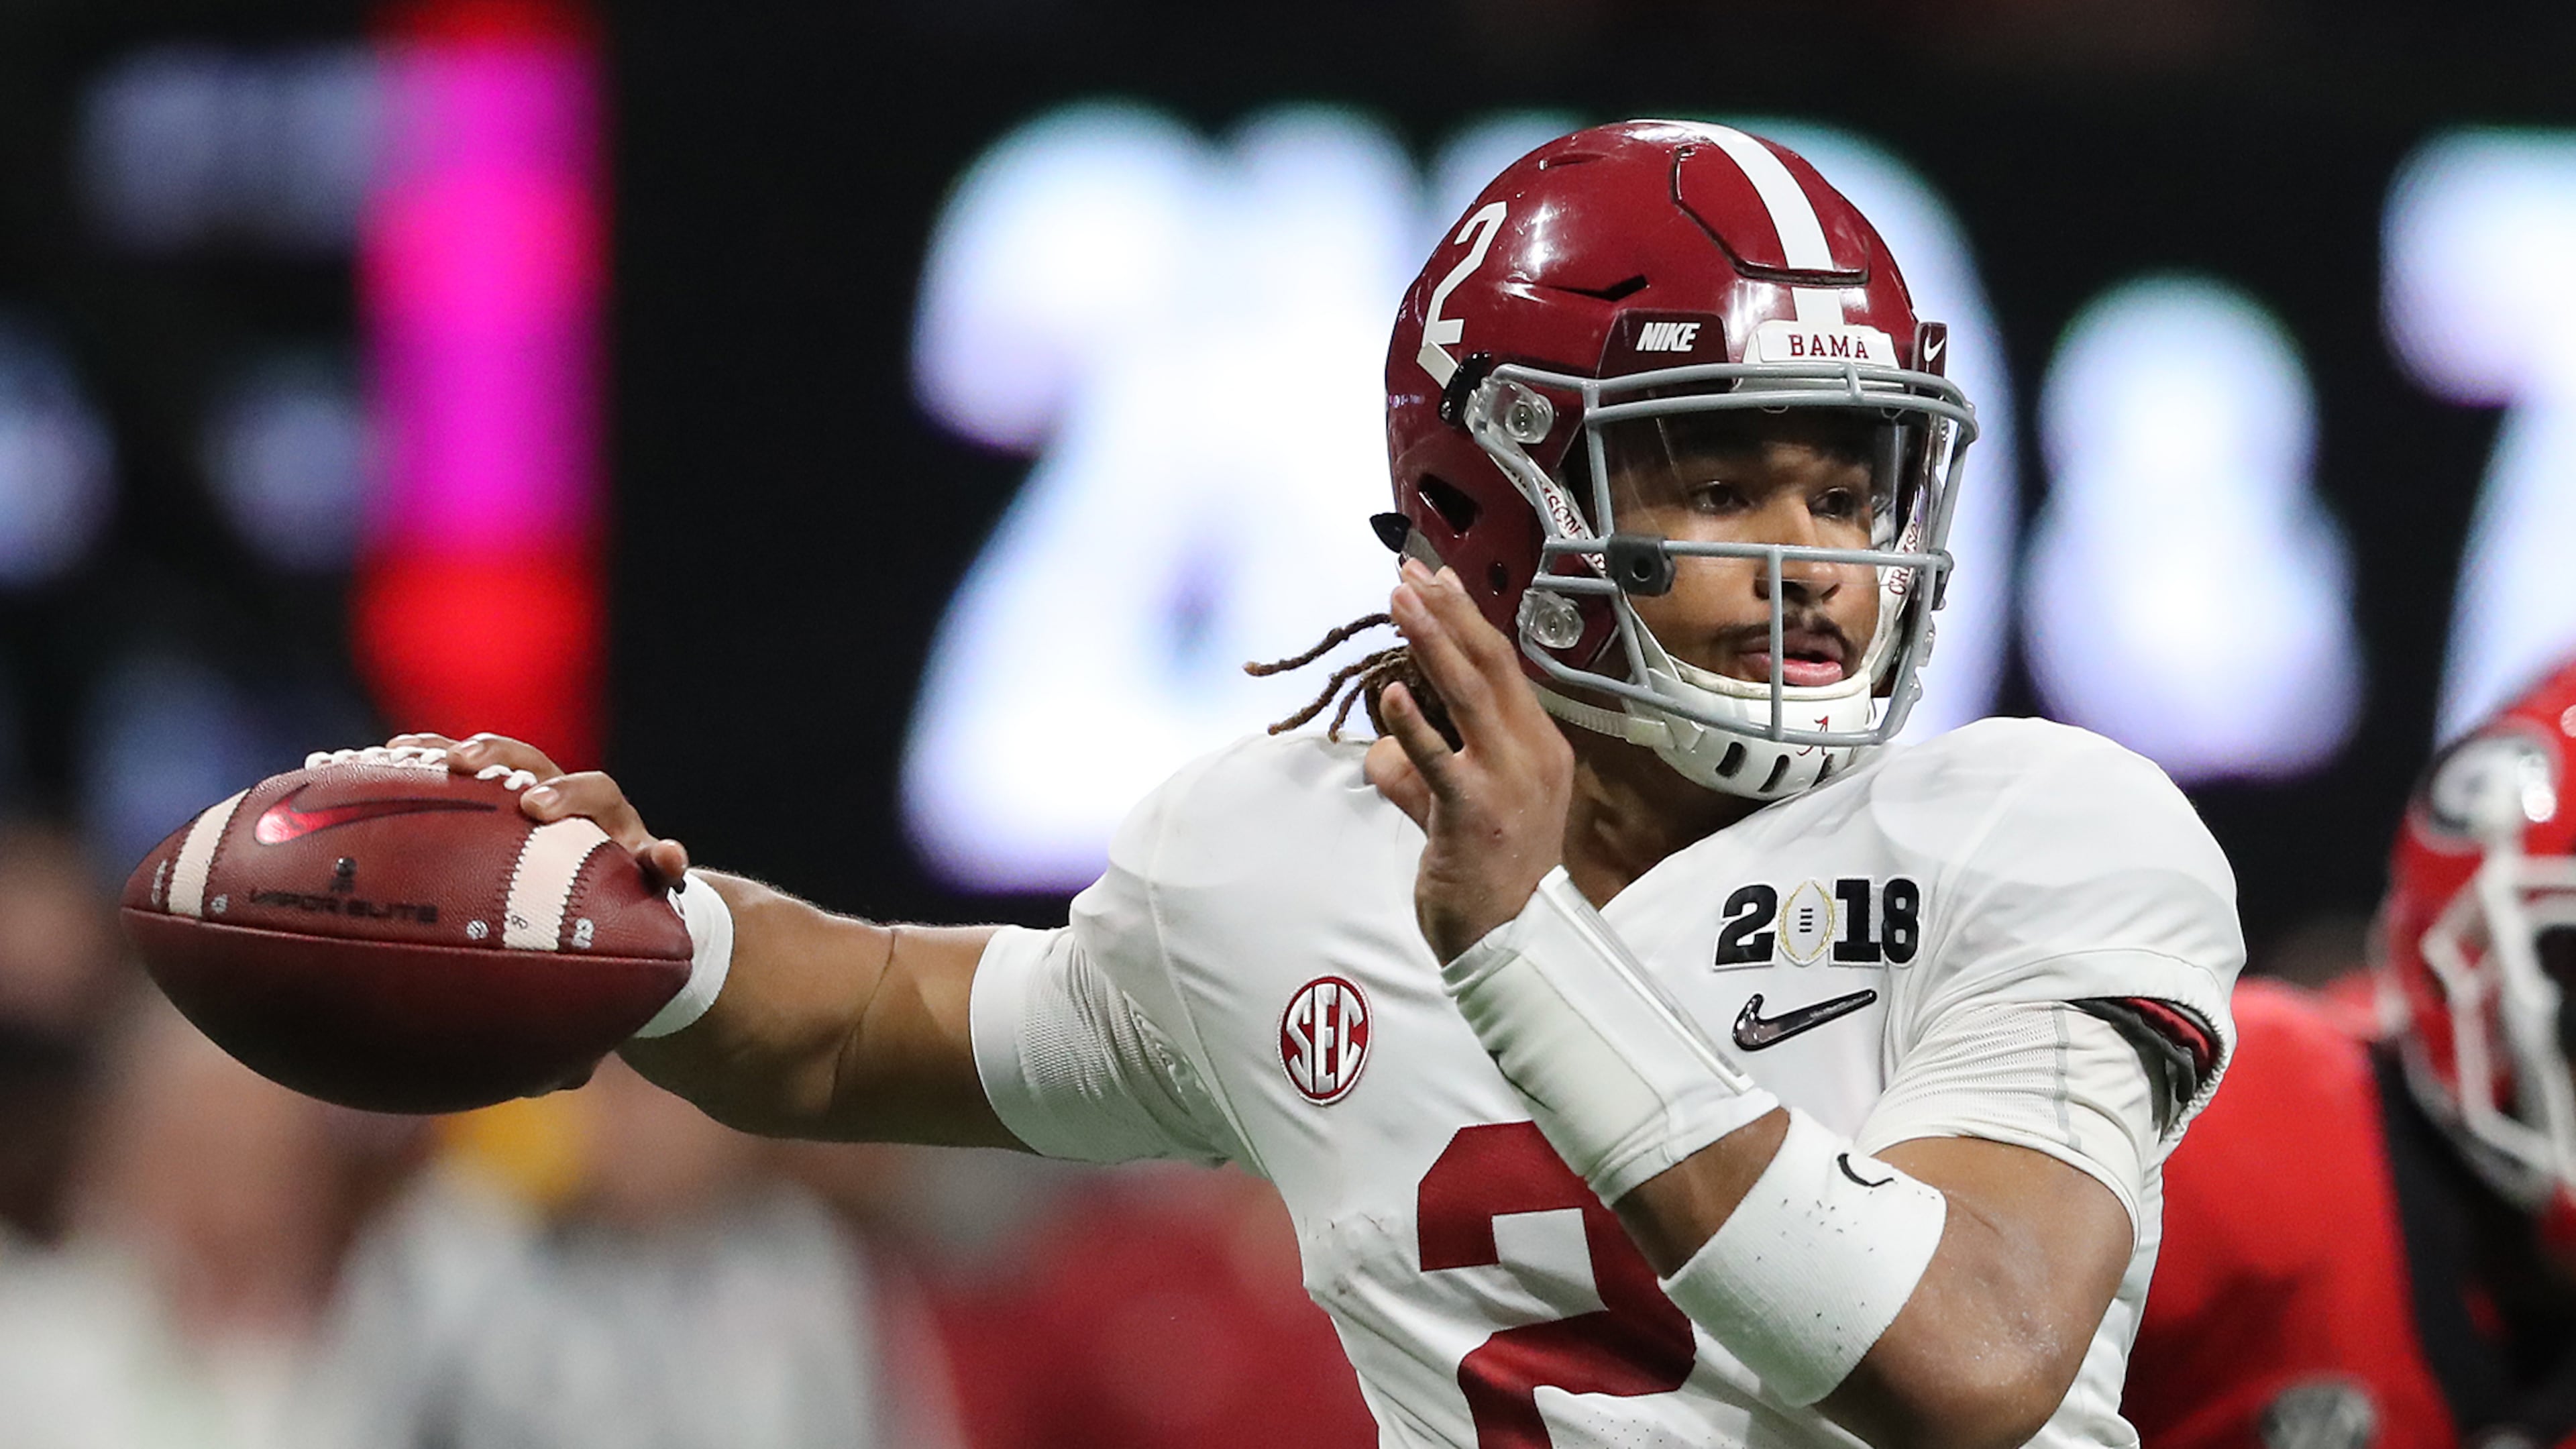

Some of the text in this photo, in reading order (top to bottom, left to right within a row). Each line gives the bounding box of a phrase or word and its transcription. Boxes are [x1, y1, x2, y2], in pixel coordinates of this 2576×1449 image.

[1416, 201, 1507, 389] 2
[1635, 322, 1701, 352] NIKE
[1788, 334, 1869, 359] BAMA
[1715, 878, 1920, 966] 2018
[1285, 983, 1364, 1094] SEC
[1417, 1120, 1697, 1449] 2
